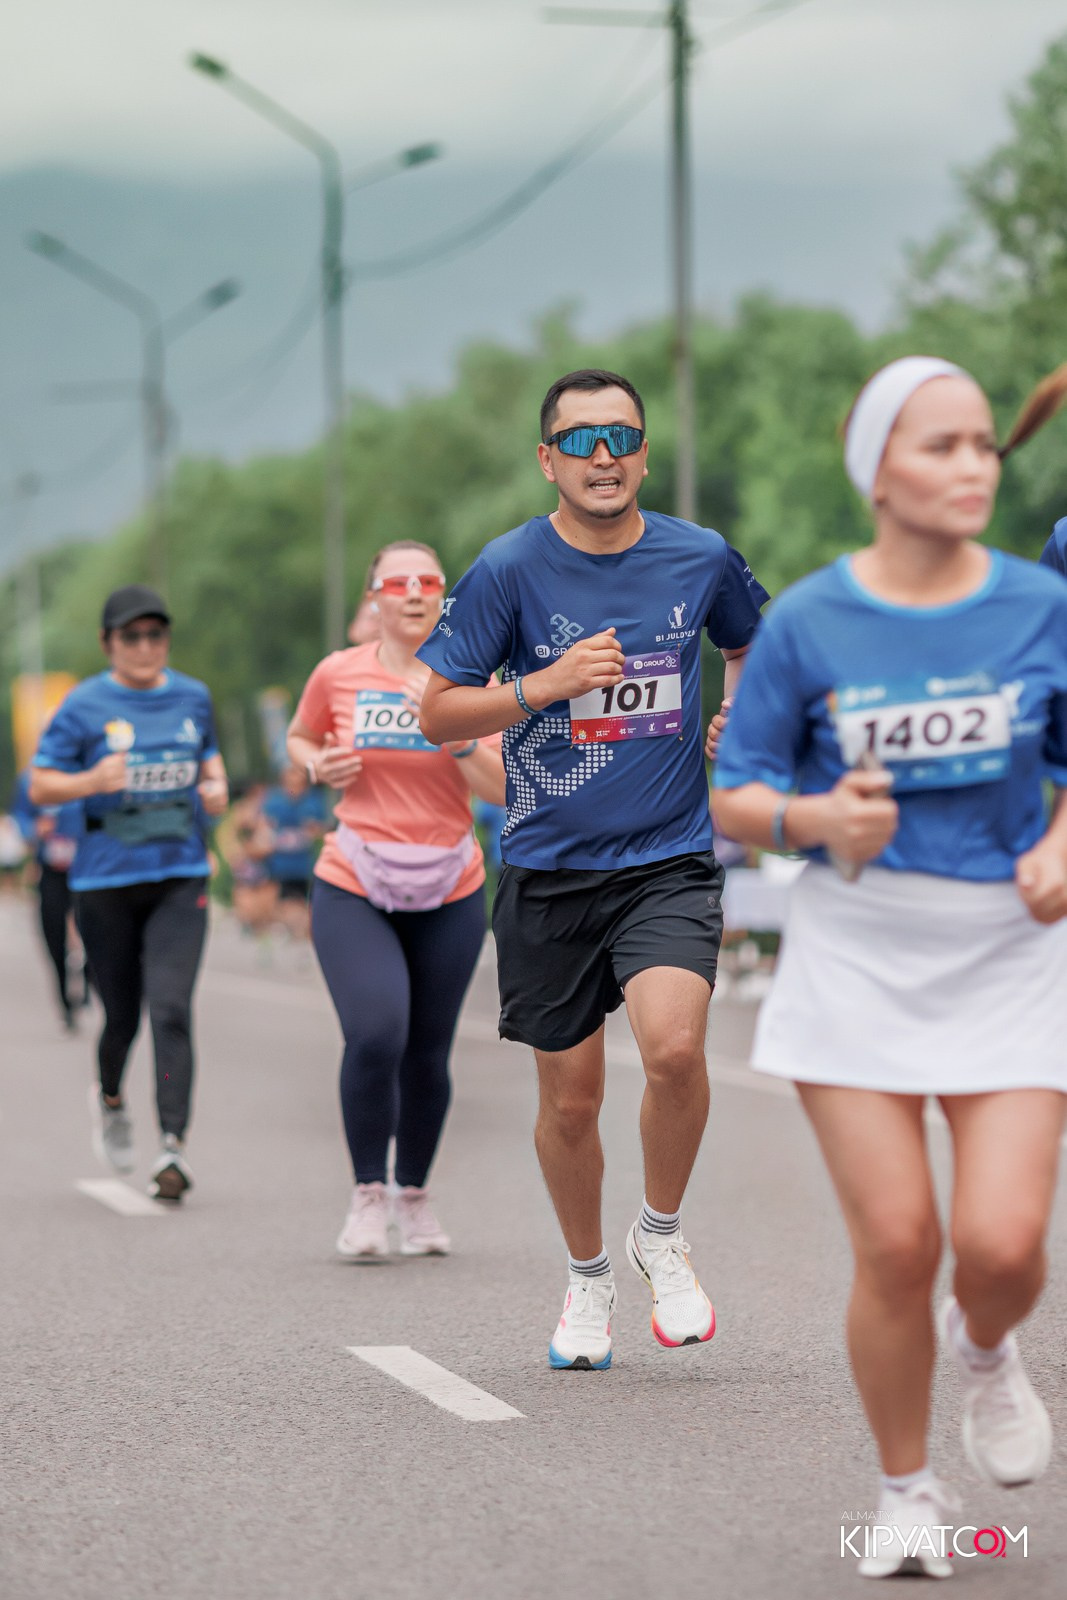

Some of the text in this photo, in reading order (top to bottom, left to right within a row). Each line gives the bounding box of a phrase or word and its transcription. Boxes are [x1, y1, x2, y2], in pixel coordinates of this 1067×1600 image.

[601, 680, 658, 714] 101
[365, 709, 420, 729] 100
[864, 708, 987, 751] 1402
